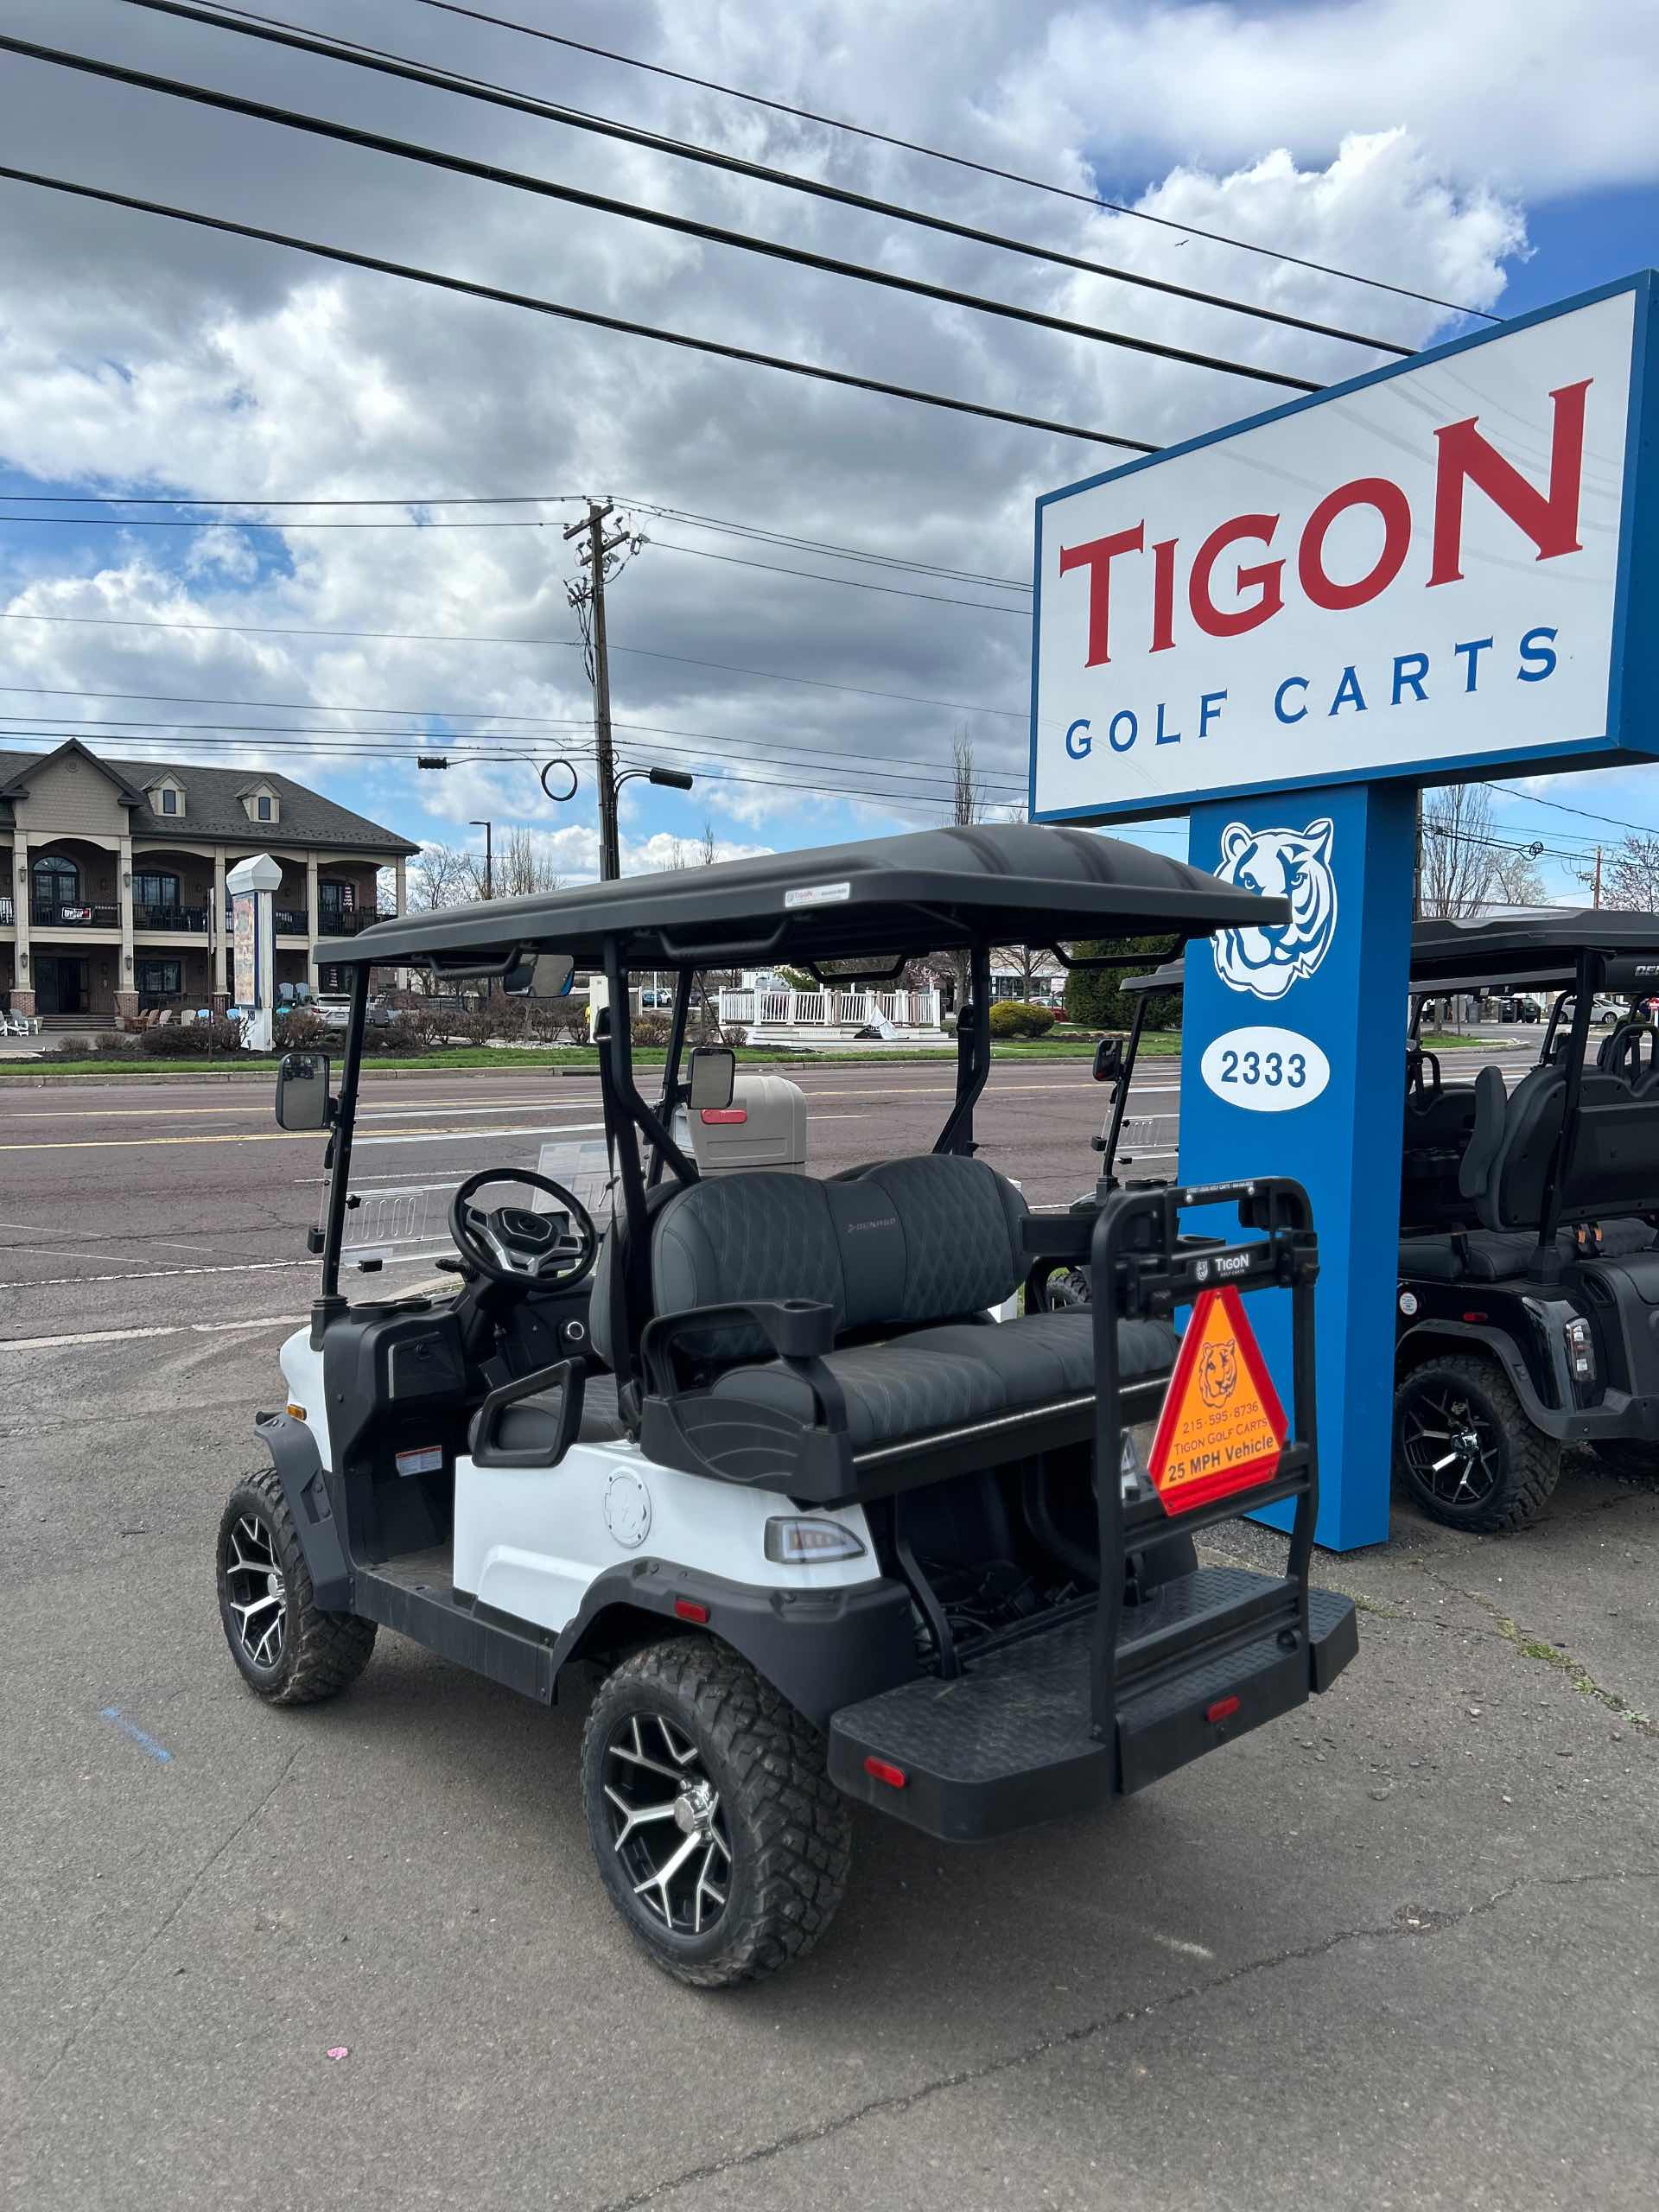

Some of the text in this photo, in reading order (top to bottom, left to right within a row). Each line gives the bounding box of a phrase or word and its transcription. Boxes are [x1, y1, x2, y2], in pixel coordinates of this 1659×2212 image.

[1059, 378, 1593, 670] TIGON
[1065, 626, 1559, 760] GOLF CARTS
[1221, 1050, 1306, 1089] 2333
[1215, 1254, 1249, 1271] TIGON
[1168, 1434, 1274, 1483] 25 MPH Vehicle
[1173, 1418, 1268, 1456] TIGON GOLF CARTS
